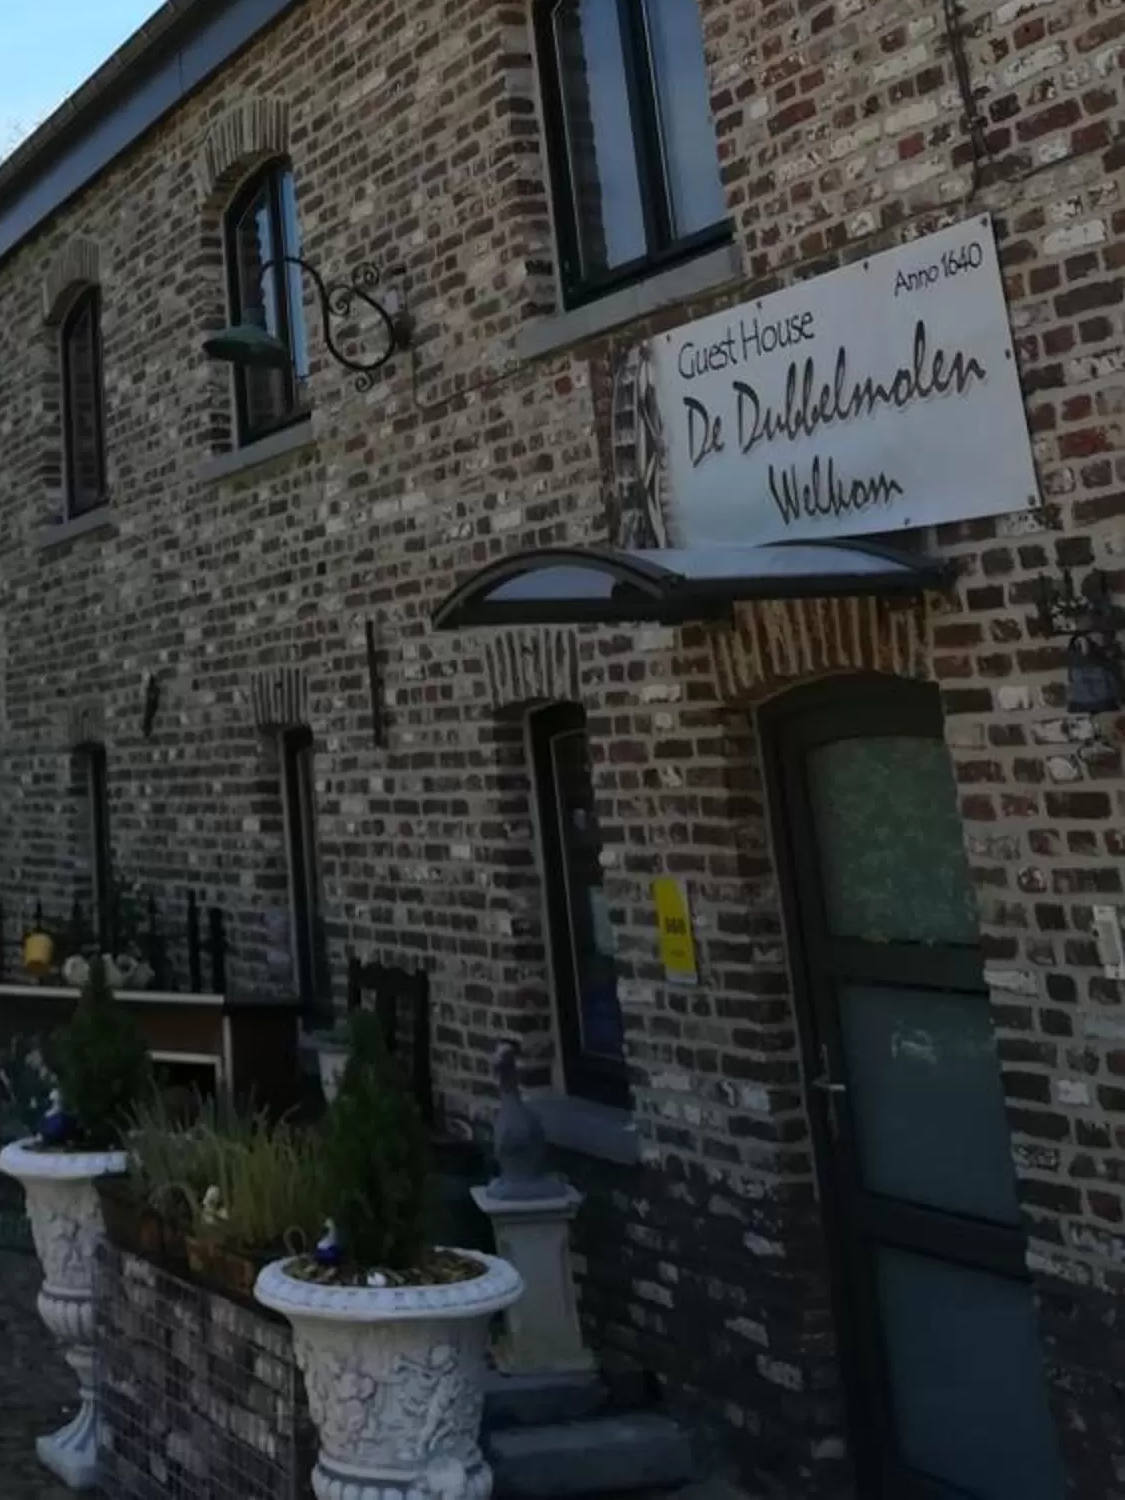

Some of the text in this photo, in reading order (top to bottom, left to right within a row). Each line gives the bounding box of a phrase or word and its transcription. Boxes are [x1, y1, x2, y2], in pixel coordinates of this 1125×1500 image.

[894, 242, 983, 296] Anno 1640
[678, 311, 815, 380] Guest House
[683, 321, 986, 468] De Dubbelmolen
[768, 454, 904, 526] Welkom
